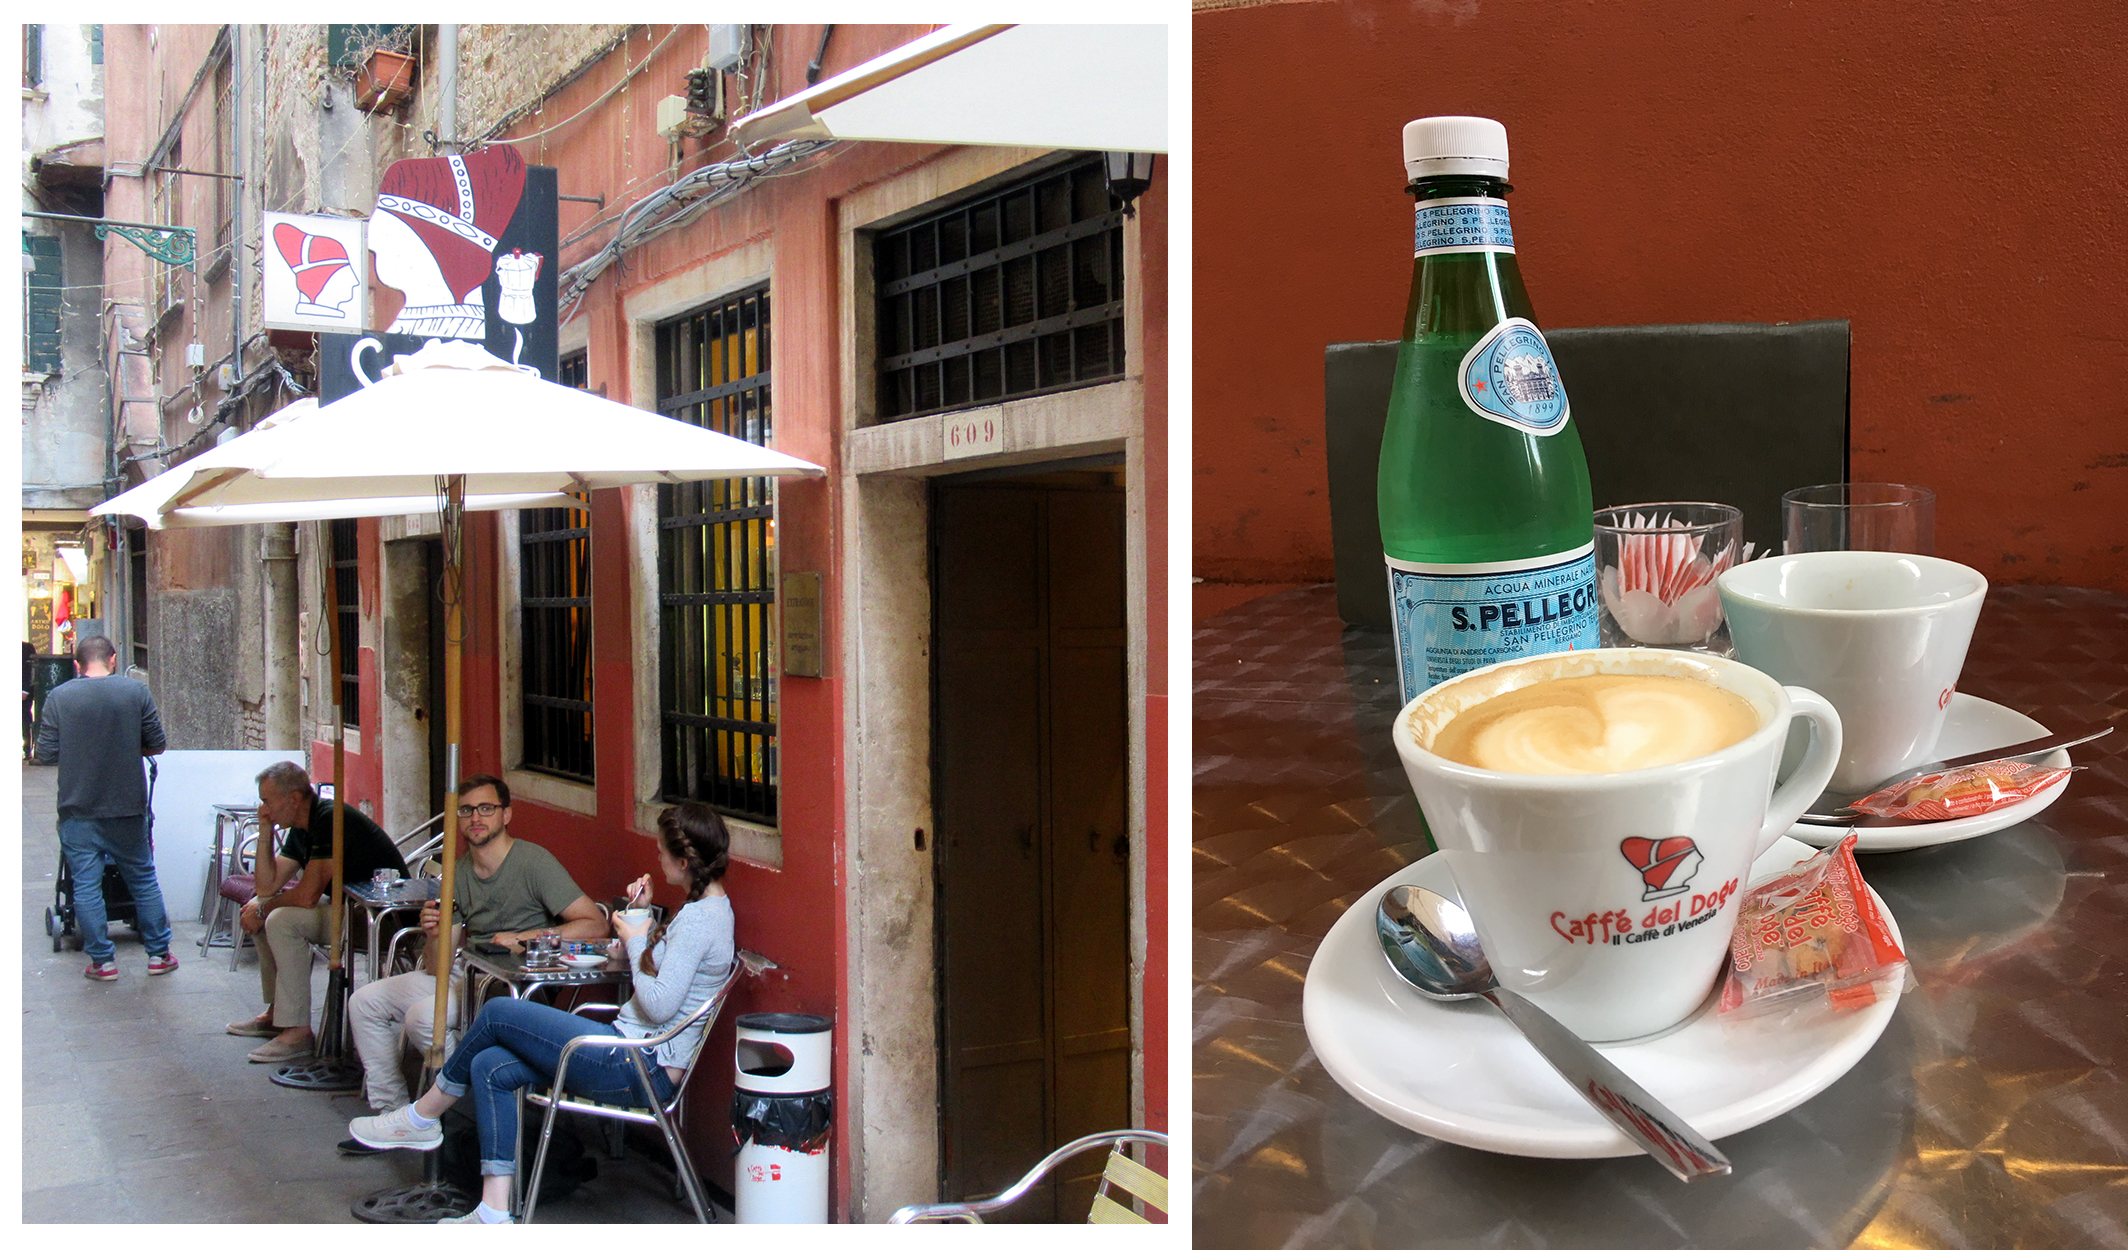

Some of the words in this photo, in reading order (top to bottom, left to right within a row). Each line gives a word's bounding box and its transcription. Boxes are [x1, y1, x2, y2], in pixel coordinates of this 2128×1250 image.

[1493, 336, 1545, 374] PELLEGRINO
[1496, 380, 1516, 406] SAN
[1528, 402, 1554, 415] 1899
[950, 419, 994, 448] 609
[1485, 582, 1530, 596] ACQUA
[1534, 570, 1579, 589] MINERALE
[1500, 622, 1551, 637] STABILIMENTO
[1503, 634, 1529, 647] SAN
[1534, 619, 1587, 642] PELLEGRINO
[1554, 630, 1582, 645] BERGAMO
[1426, 646, 1452, 655] AGGIUNTA
[1460, 648, 1487, 656] ANIDRIDE
[1487, 645, 1524, 655] CARBONICA
[1641, 900, 1682, 930] del
[1689, 877, 1739, 918] Doge
[1612, 934, 1621, 946] Il
[1625, 929, 1660, 945] Caffè
[1663, 922, 1676, 937] di
[1678, 907, 1717, 933] Venezia
[1751, 912, 1781, 945] oge
[1783, 916, 1813, 948] del
[1834, 903, 1859, 933] Doge
[1753, 971, 1791, 990] Made
